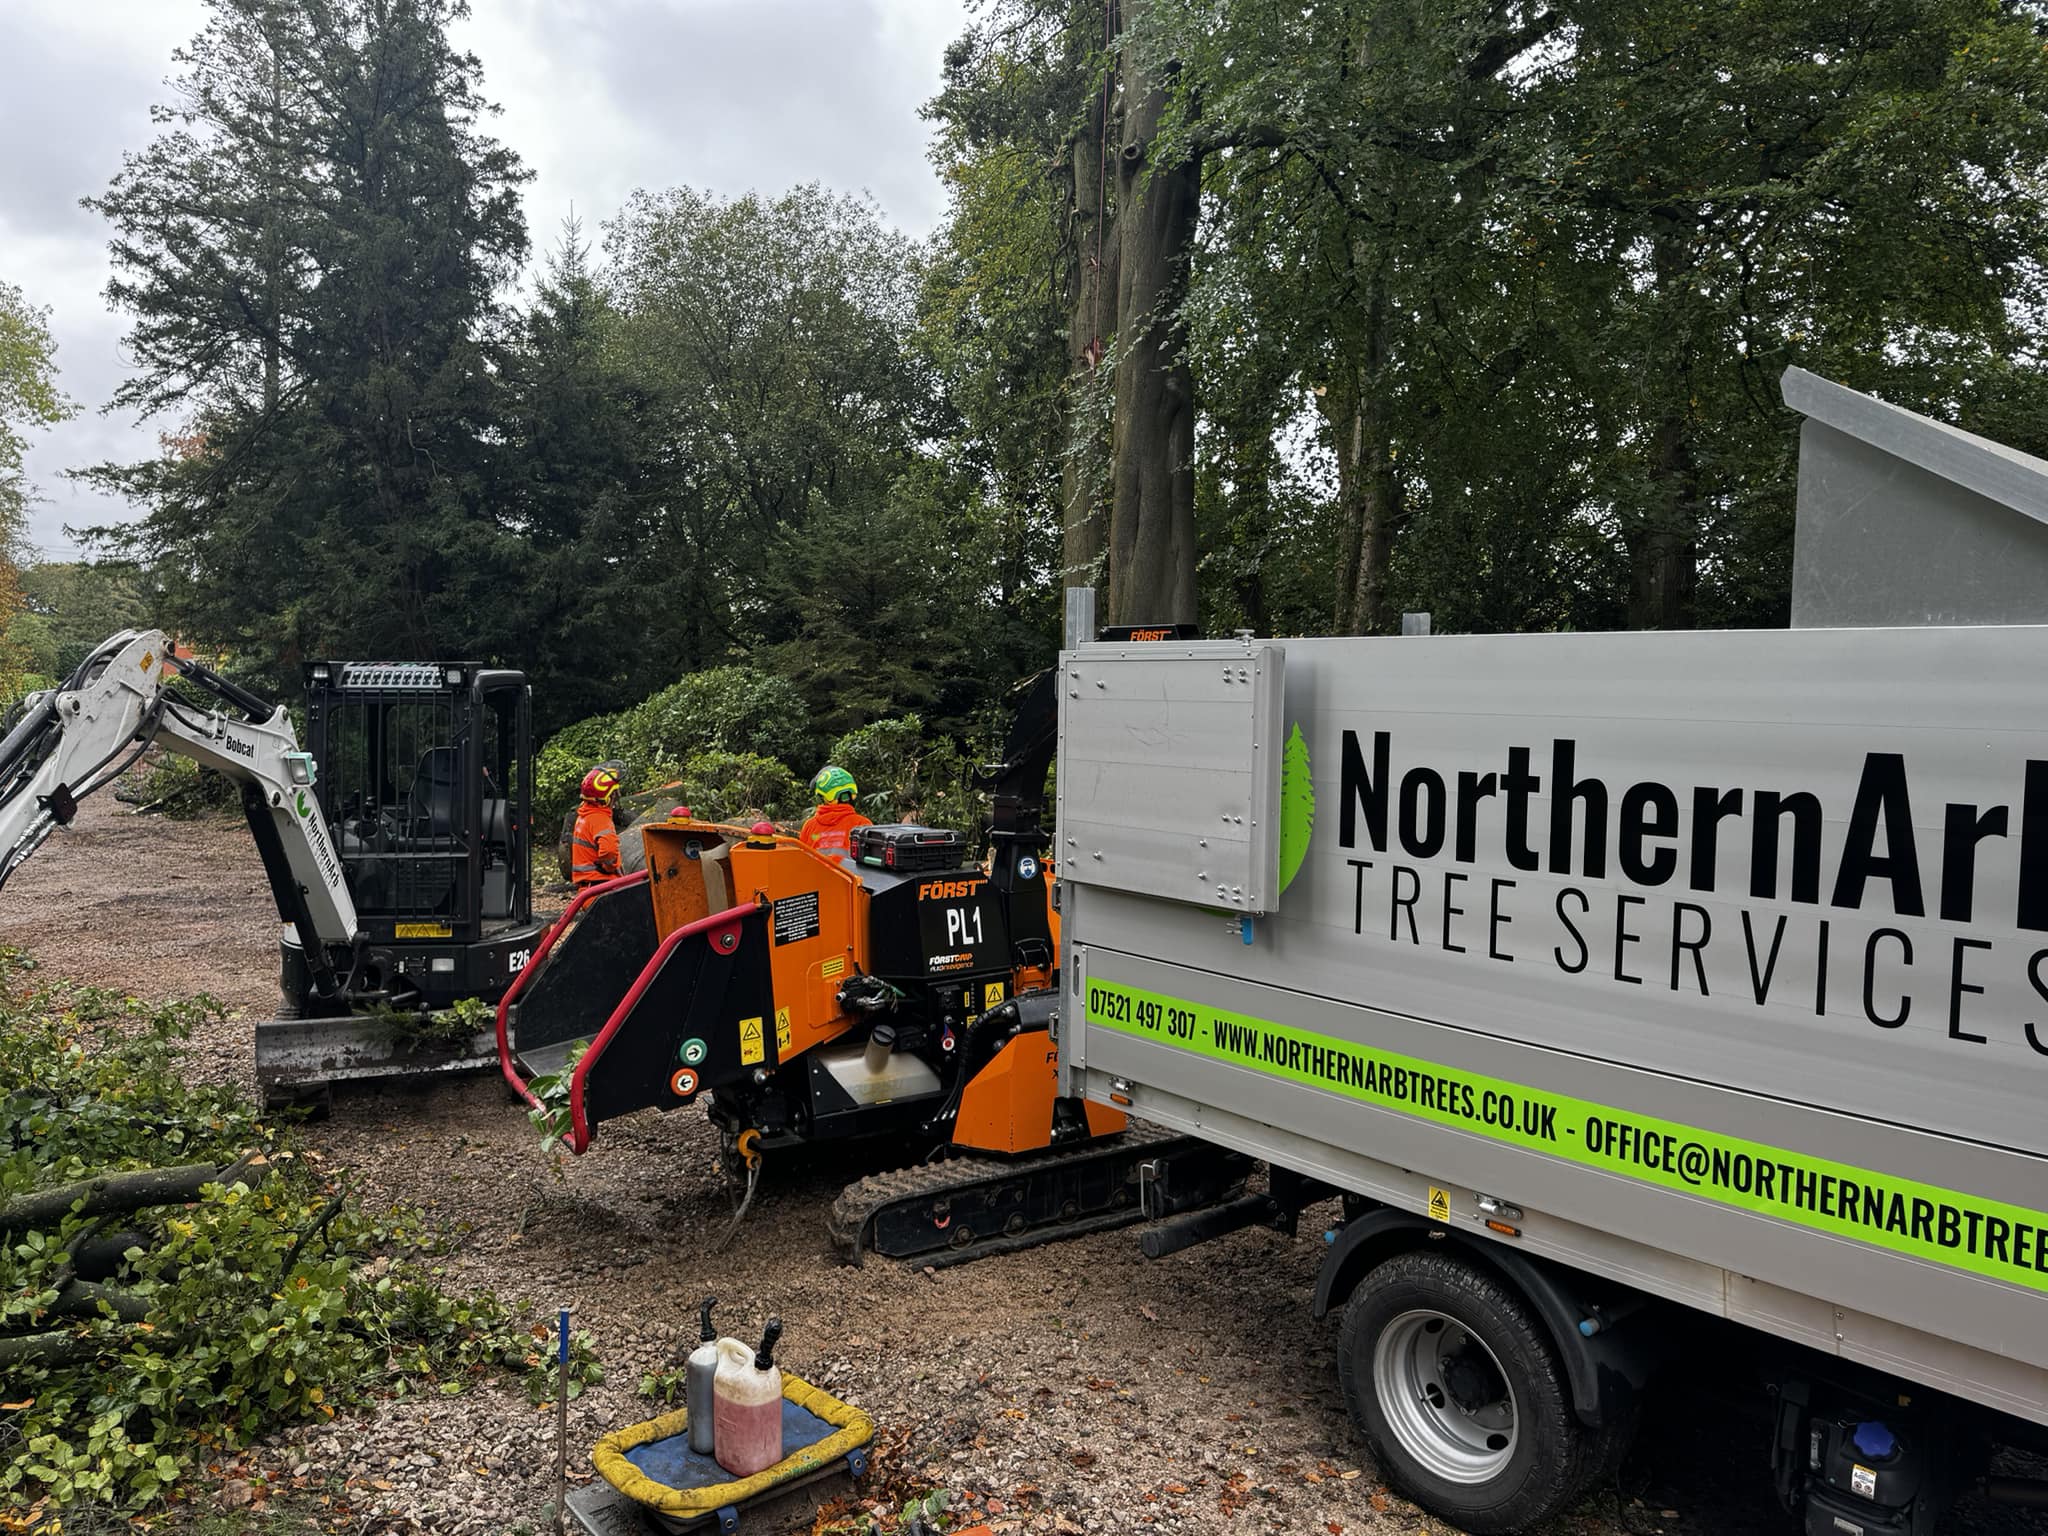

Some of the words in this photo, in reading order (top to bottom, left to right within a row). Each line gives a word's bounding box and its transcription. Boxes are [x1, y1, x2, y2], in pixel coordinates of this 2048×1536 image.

[1130, 629, 1172, 642] FÖRST
[226, 735, 254, 758] Bobcat
[308, 813, 340, 887] NorthernArb
[919, 880, 988, 901] FÖRST
[946, 906, 983, 947] PL1
[1347, 859, 1516, 962] TREE
[509, 949, 530, 973] E26
[1091, 988, 1130, 1023] 07521
[1136, 1000, 1163, 1031] 497
[1168, 1008, 1196, 1040] 307
[1214, 1019, 1557, 1142] WWW.NORTHERNARBTREES.CO.UK
[1586, 1116, 2048, 1274] OFFICE@NORTHERNARBTREE
